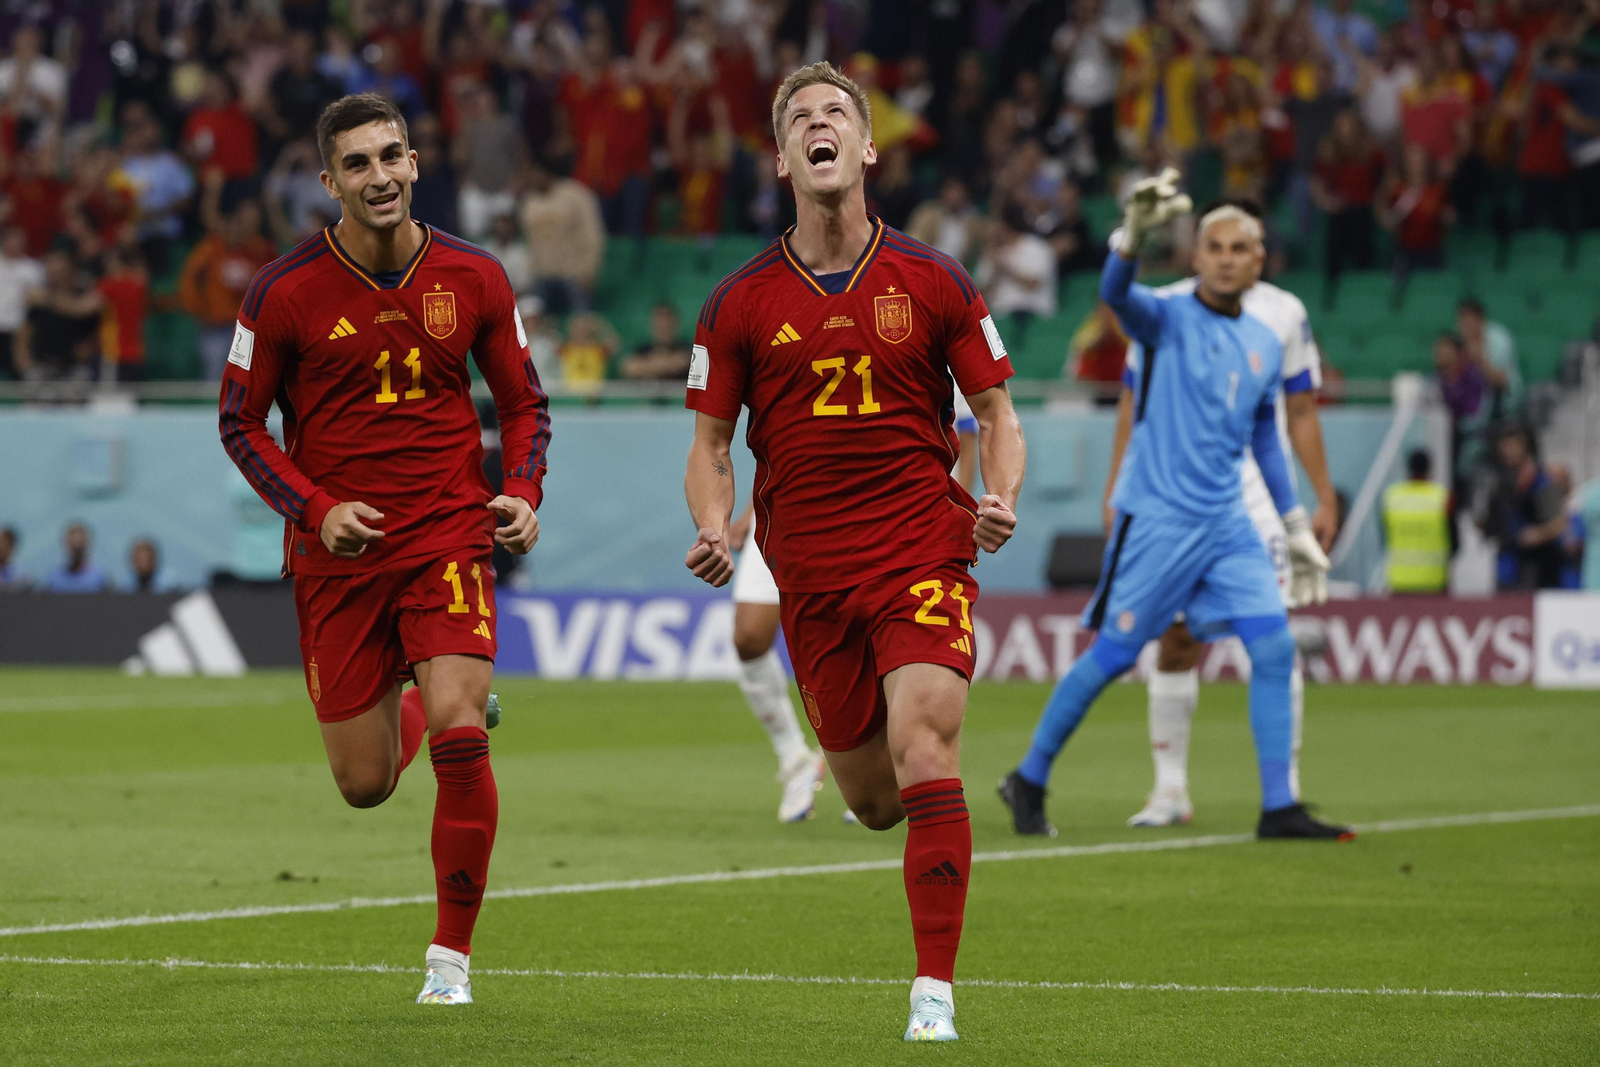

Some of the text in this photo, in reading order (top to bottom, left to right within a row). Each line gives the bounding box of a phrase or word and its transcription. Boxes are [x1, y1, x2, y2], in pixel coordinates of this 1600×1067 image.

[373, 347, 425, 404] 11
[811, 355, 881, 416] 21
[1227, 370, 1239, 409] 1
[442, 560, 491, 618] 11
[909, 579, 974, 635] 21
[510, 598, 742, 677] VISA
[915, 875, 964, 886] adidas
